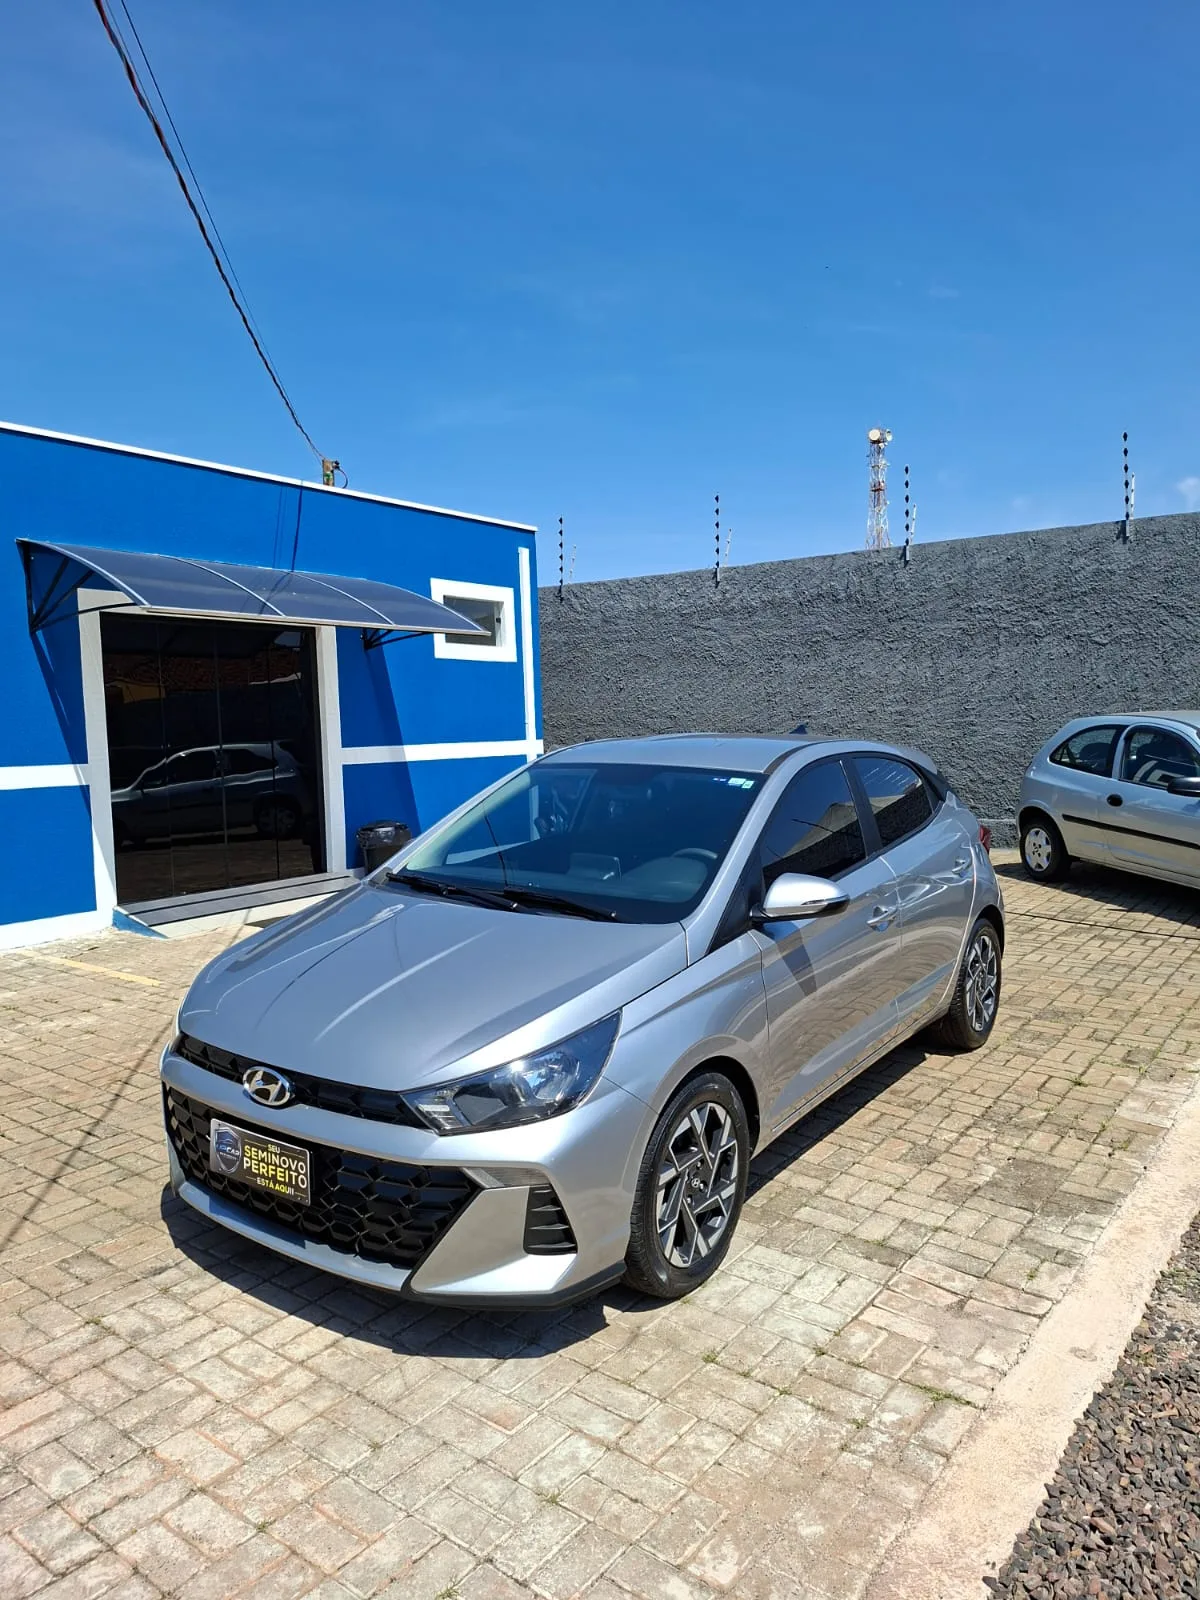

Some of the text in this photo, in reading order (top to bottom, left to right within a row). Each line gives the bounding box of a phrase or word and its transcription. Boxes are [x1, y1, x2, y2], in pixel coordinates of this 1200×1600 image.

[244, 1145, 306, 1174] SEMINOVO
[267, 1144, 281, 1153] SEU
[243, 1157, 307, 1188] PERFEITO
